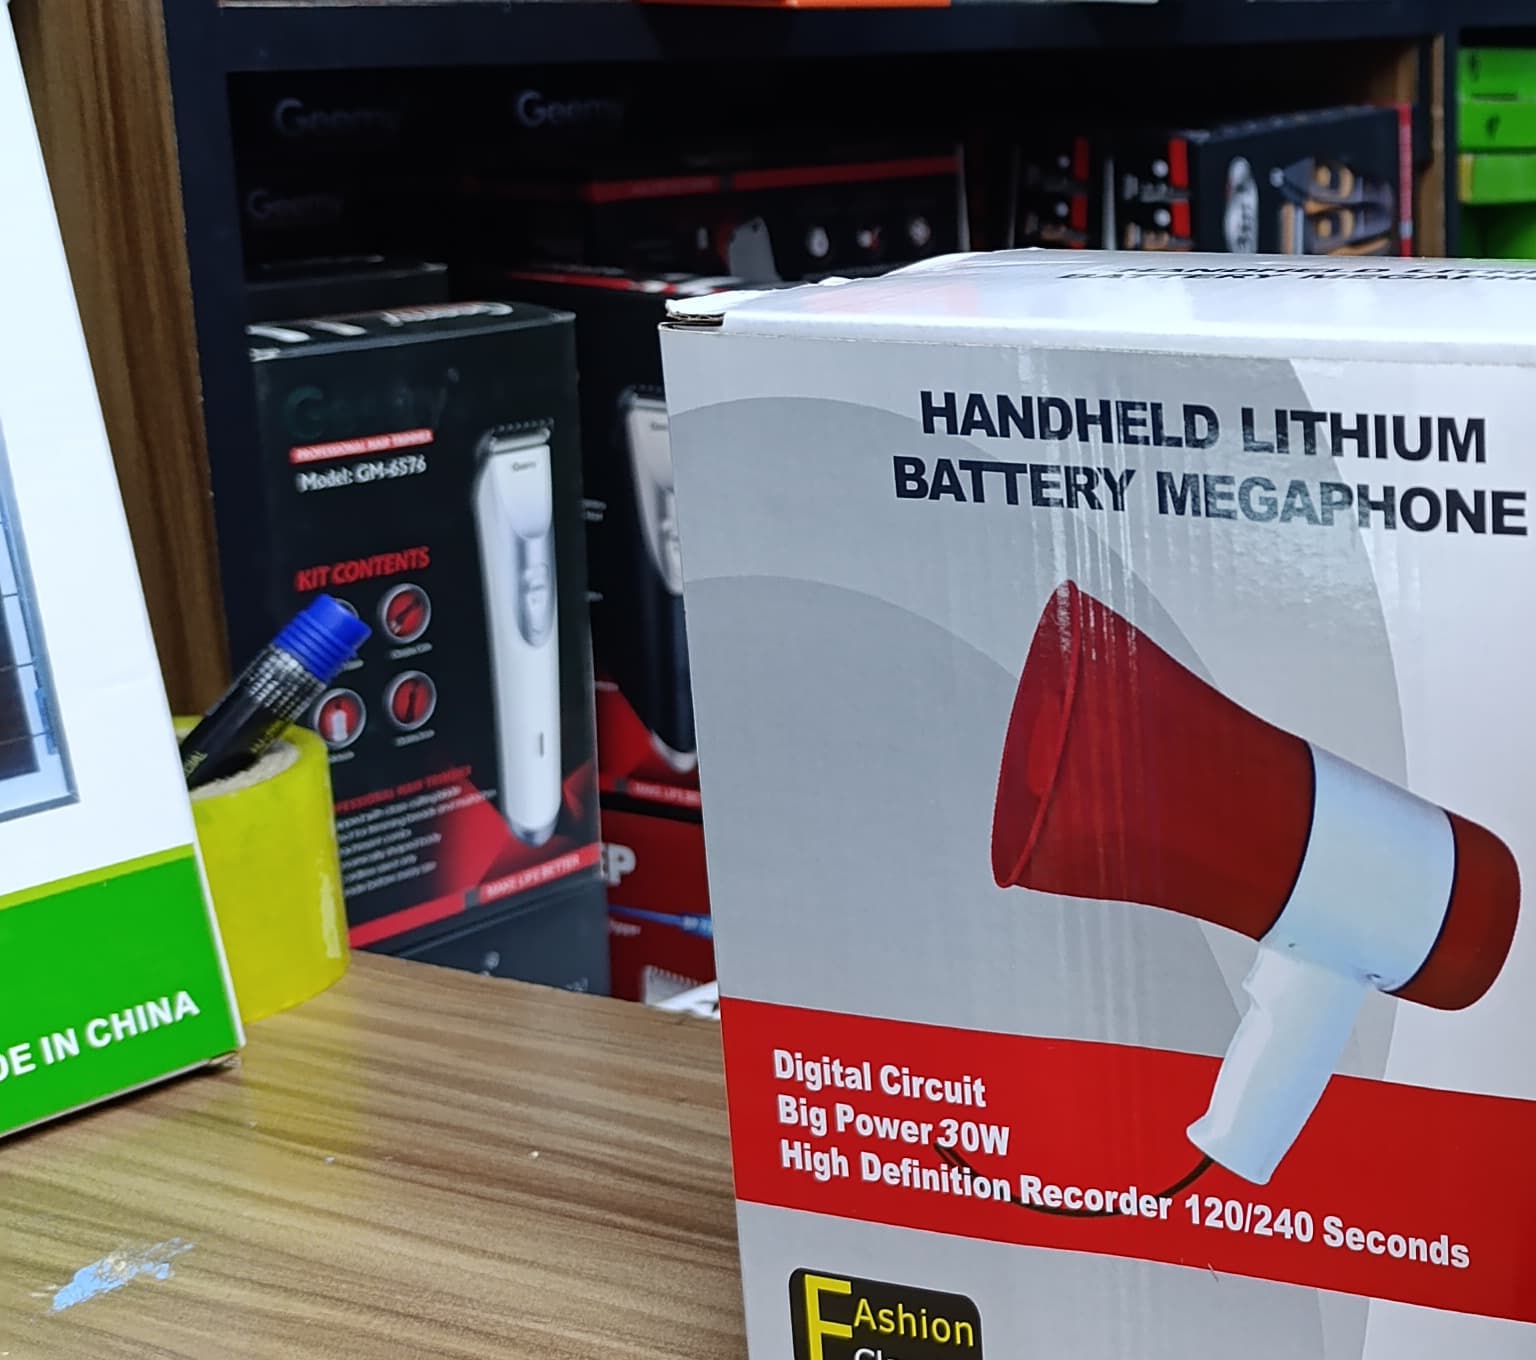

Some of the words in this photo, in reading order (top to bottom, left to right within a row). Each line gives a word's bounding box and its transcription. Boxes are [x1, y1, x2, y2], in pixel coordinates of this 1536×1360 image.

[920, 391, 1219, 452] HANDHELD
[1242, 407, 1487, 466] LITHIUM
[296, 468, 353, 493] Model:
[355, 454, 428, 484] GM-6576
[892, 455, 1136, 514] BATTERY
[1157, 471, 1529, 539] MEGAPHONE
[294, 566, 330, 592] KIT
[332, 545, 431, 585] CONTENTS
[39, 1018, 82, 1068] IN
[84, 990, 201, 1050] CHINA
[773, 1049, 872, 1093] Digital
[880, 1063, 987, 1108] Circuit
[777, 1093, 829, 1137] Big
[836, 1102, 933, 1146] Power
[936, 1118, 1010, 1157] 30W
[781, 1138, 850, 1182] High
[860, 1150, 1012, 1203] Definition
[1020, 1173, 1172, 1220] Recorder
[1184, 1192, 1314, 1244] 120/240
[1322, 1214, 1471, 1270] Seconds
